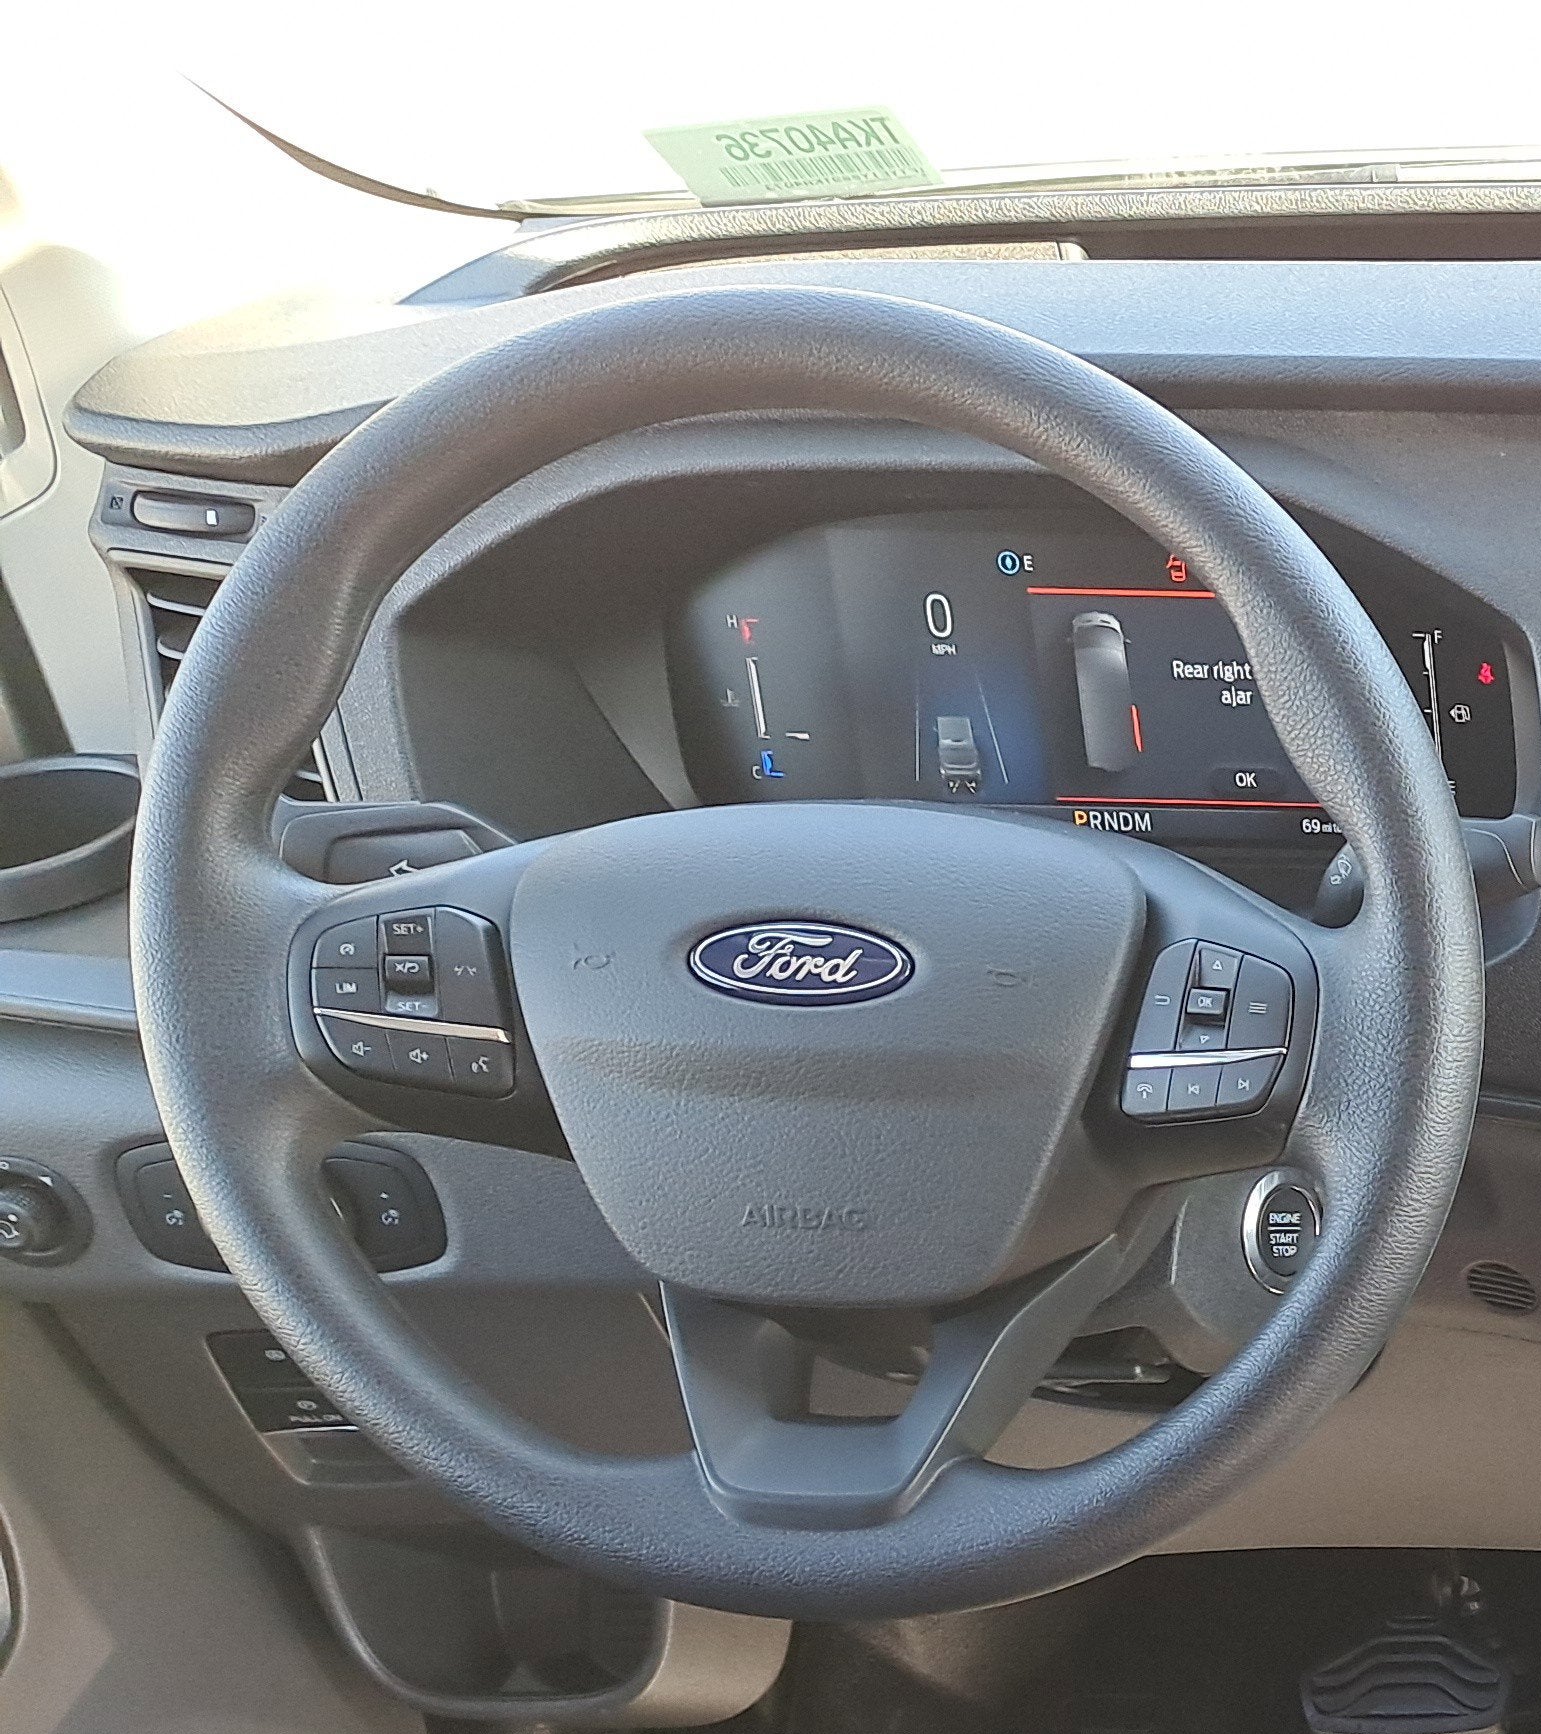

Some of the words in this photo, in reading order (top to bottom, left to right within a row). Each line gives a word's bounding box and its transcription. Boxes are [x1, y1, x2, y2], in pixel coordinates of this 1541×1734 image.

[926, 593, 951, 638] 0
[931, 643, 957, 656] MPH
[1172, 660, 1209, 680] Rear
[1213, 660, 1252, 682] right
[1220, 686, 1252, 707] ajar
[1234, 772, 1258, 788] OK
[1302, 818, 1321, 833] 69
[733, 931, 863, 984] Ford
[741, 1204, 868, 1231] AIRBAG
[1268, 1212, 1302, 1224] ENGINE
[1269, 1234, 1299, 1245] START
[1272, 1245, 1298, 1257] STOP
